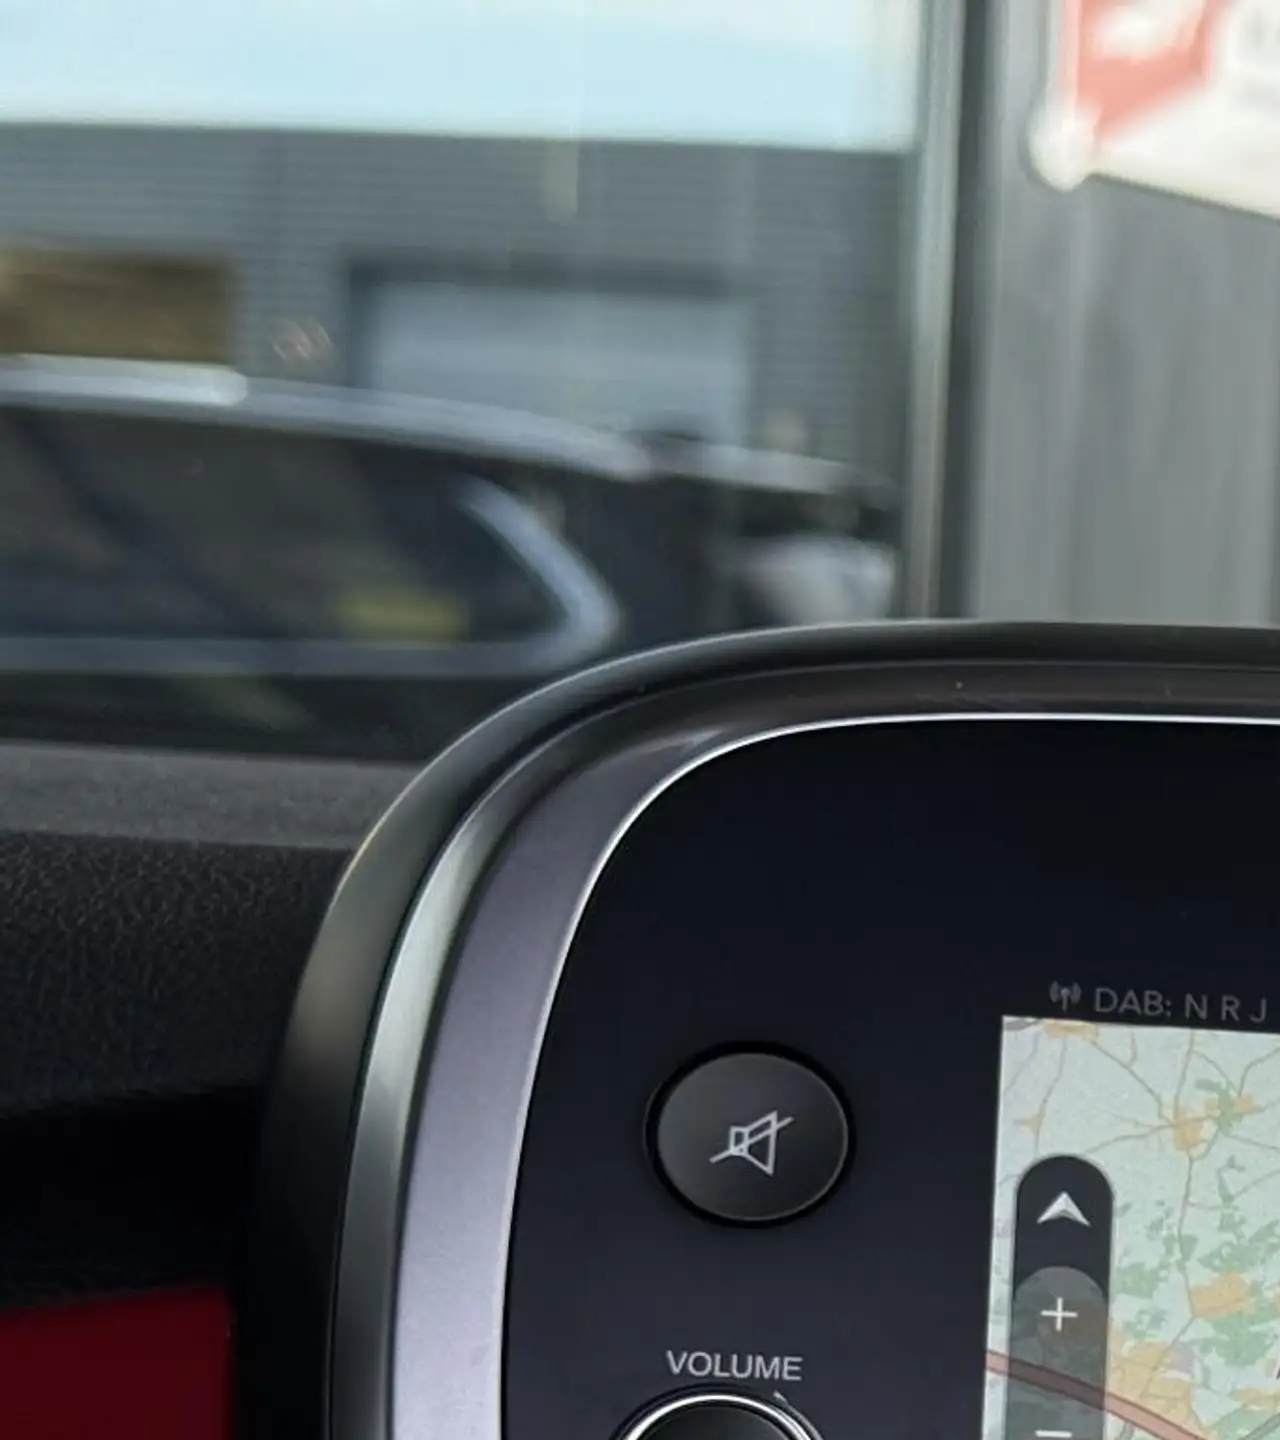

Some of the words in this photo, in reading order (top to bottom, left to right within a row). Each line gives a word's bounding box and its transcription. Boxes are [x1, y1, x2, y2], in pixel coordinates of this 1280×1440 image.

[1093, 986, 1173, 1019] DAB:
[1184, 995, 1208, 1021] N
[1220, 998, 1241, 1022] R
[1250, 1000, 1268, 1023] J
[666, 1350, 803, 1382] VOLUME
